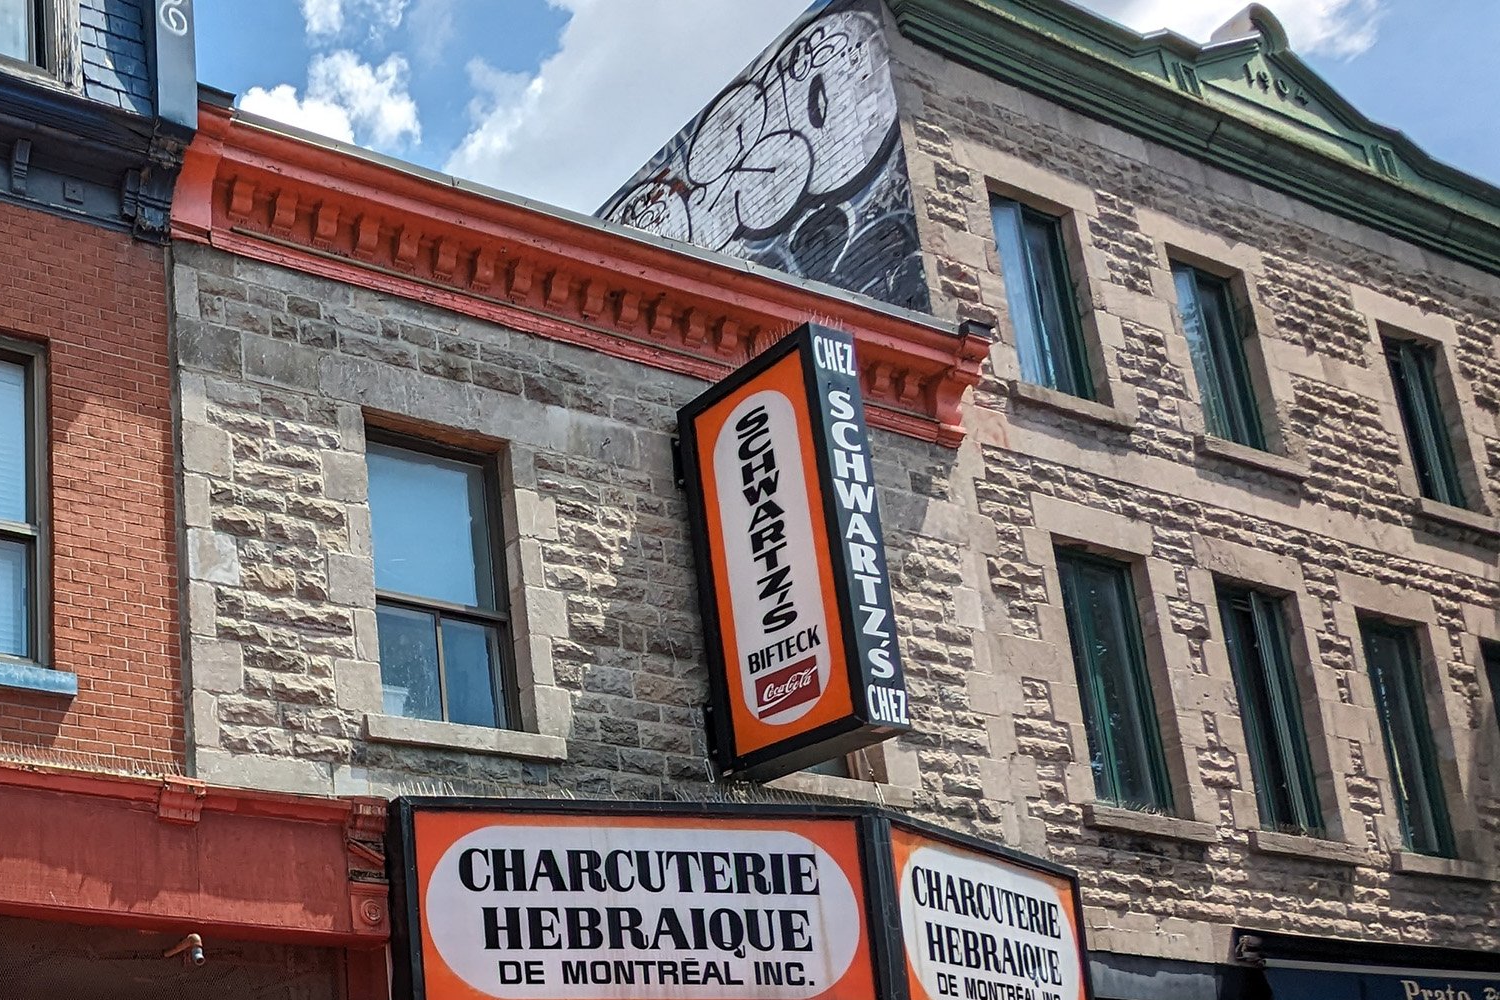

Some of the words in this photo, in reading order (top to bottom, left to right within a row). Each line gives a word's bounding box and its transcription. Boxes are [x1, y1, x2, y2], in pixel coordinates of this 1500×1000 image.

[813, 335, 856, 377] CHEZ
[734, 405, 798, 635] SCHWARTZ'S
[827, 389, 895, 680] SCHWARTZ'S
[747, 624, 821, 674] BIFTECK
[866, 684, 910, 726] CHEZ
[458, 847, 821, 895] CHARCUTERIE
[910, 865, 1062, 939] CHARCUTERIE
[483, 907, 813, 957] HEBRAIQUE
[925, 920, 1063, 989] HEBRAIQUE
[499, 960, 545, 985] DE
[562, 956, 744, 986] MONTRÉAL
[755, 961, 815, 986] INC.
[937, 972, 959, 998] DE
